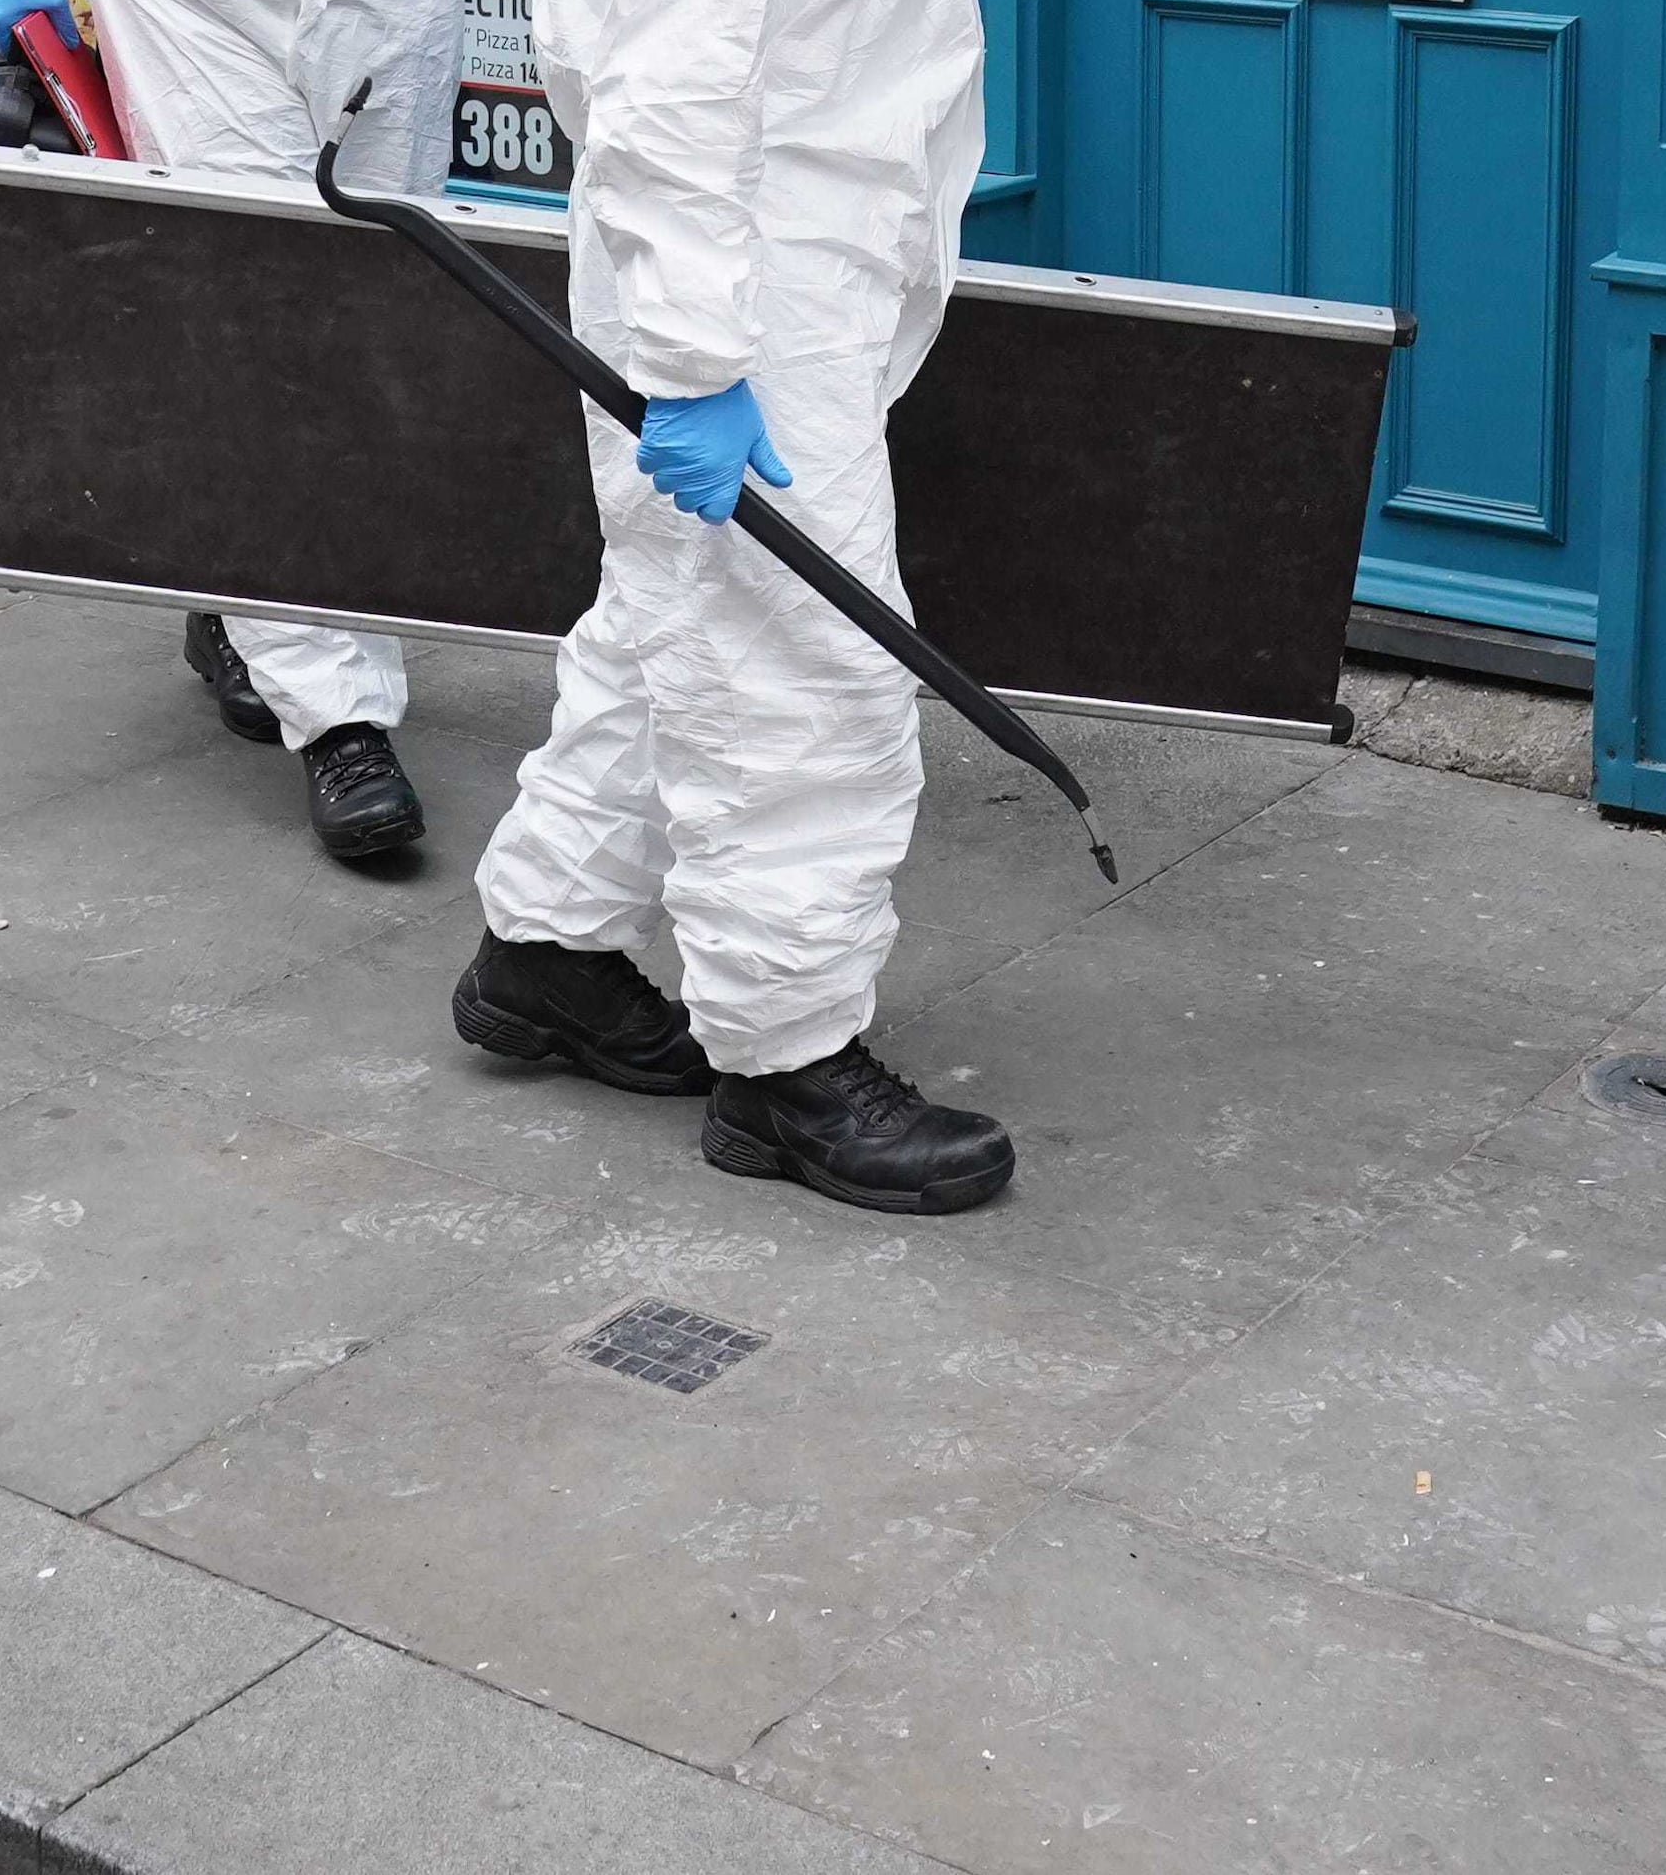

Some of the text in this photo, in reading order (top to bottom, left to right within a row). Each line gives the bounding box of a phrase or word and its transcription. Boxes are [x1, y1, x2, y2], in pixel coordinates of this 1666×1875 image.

[476, 28, 519, 52] Pizza
[471, 56, 514, 80] Pizza
[460, 98, 554, 176] 388
